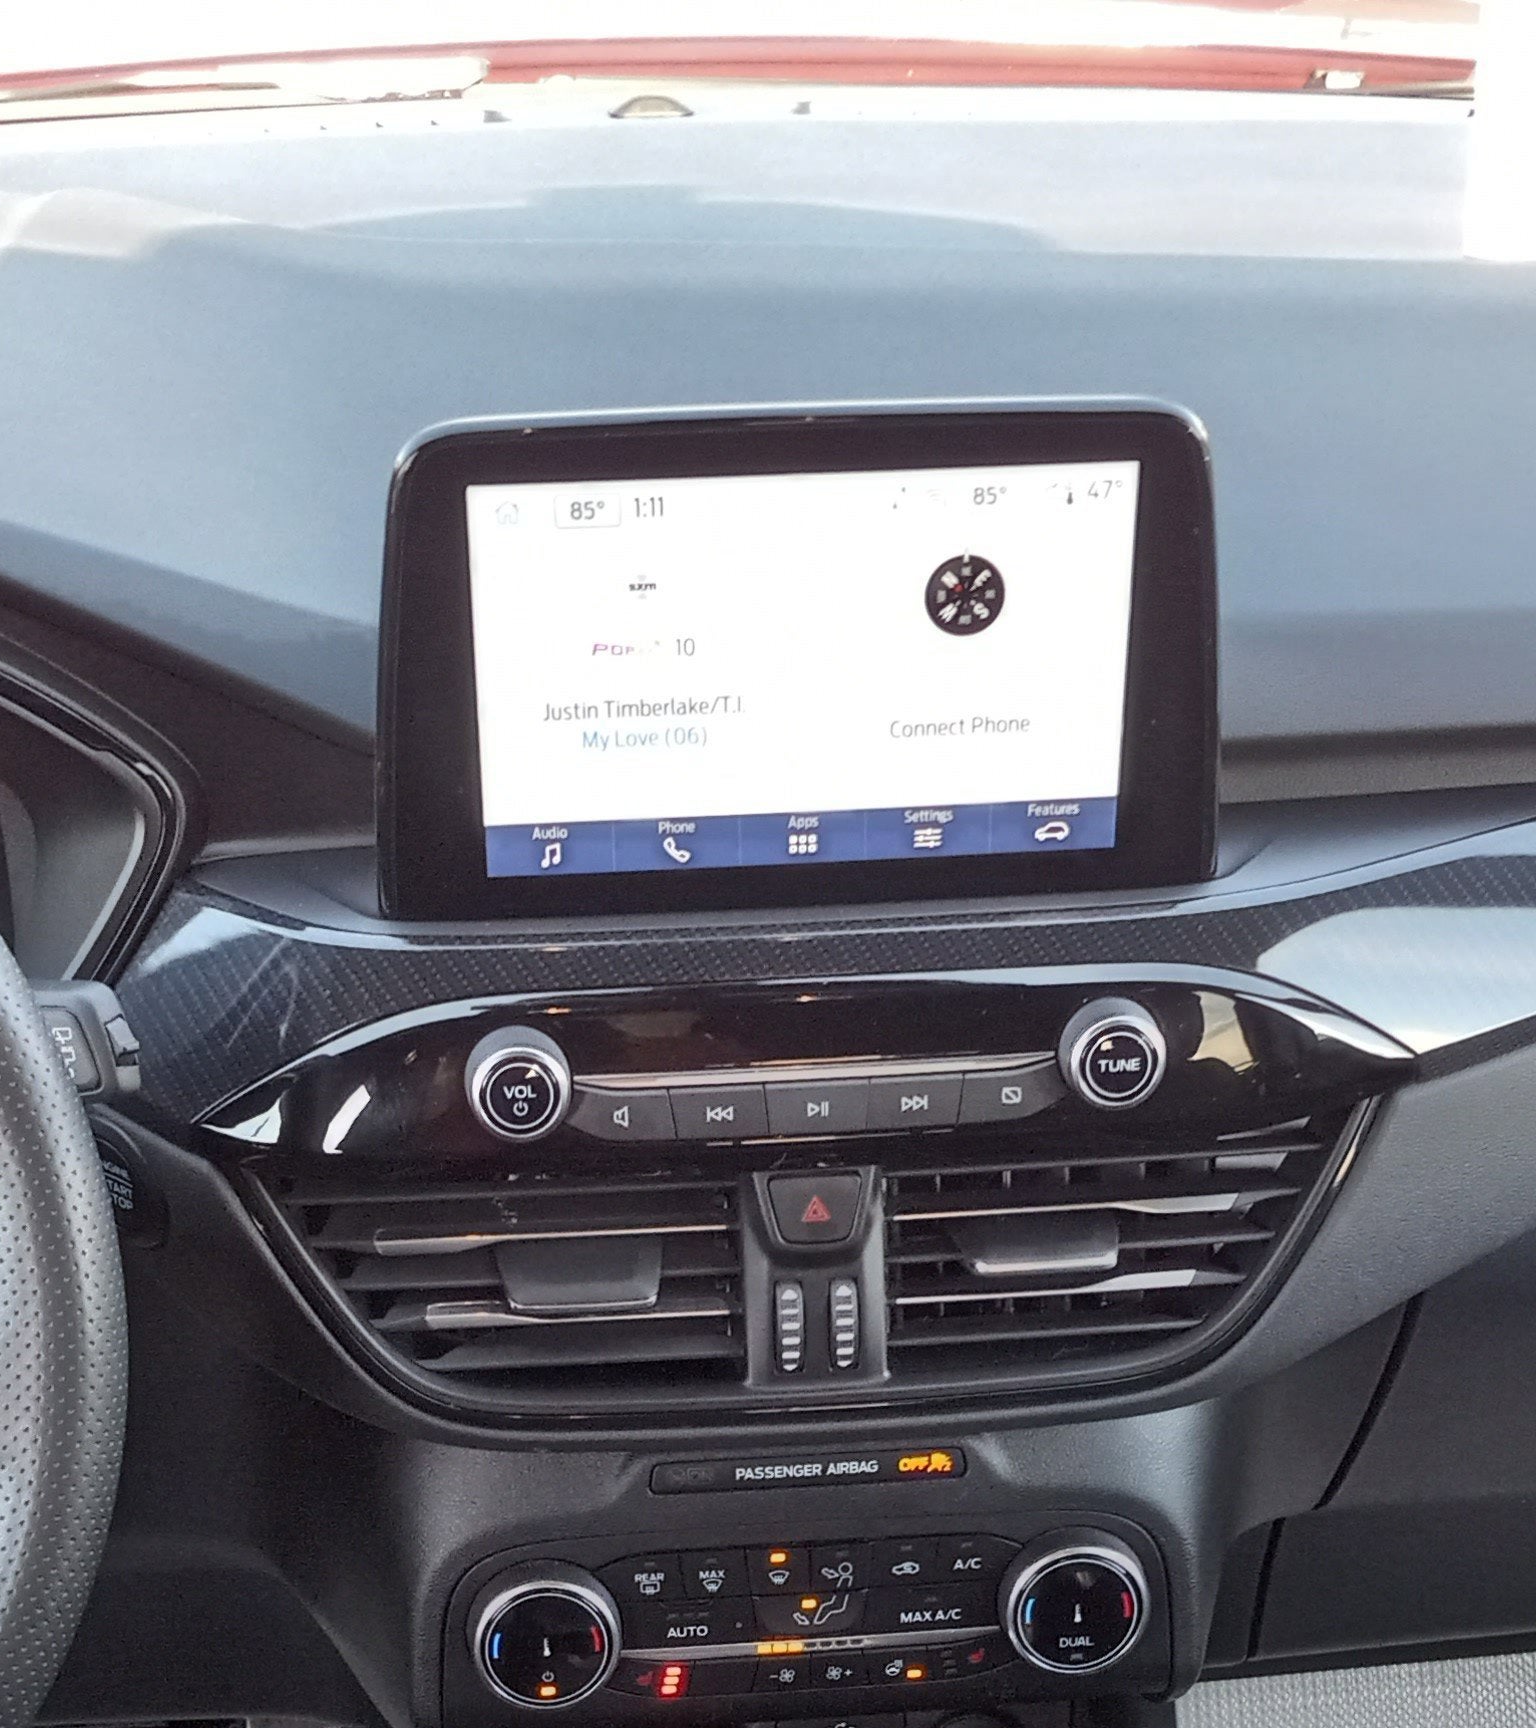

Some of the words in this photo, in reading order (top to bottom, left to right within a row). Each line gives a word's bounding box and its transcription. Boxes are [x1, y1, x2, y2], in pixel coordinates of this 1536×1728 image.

[633, 496, 665, 518] 1:11
[675, 637, 696, 657] 10
[543, 700, 599, 722] Justin
[889, 718, 966, 739] Connect
[971, 716, 1031, 736] Phone
[582, 731, 609, 752] My
[614, 729, 660, 748] Love
[665, 726, 709, 748] (06)
[903, 808, 955, 825] Settings
[1027, 802, 1081, 818] Features
[658, 820, 697, 835] Phone
[787, 814, 820, 831] Apps
[531, 825, 569, 841] Audio
[1096, 1057, 1142, 1074] TUNE
[503, 1084, 538, 1100] VOL
[734, 1462, 823, 1482] PASSENGER
[825, 1459, 880, 1477] AIRBAG
[953, 1556, 983, 1571] A/C
[633, 1572, 665, 1583] REAR
[698, 1568, 726, 1580] MAX
[900, 1610, 934, 1624] MAX
[934, 1607, 963, 1622] A/C
[666, 1624, 709, 1639] AUTO
[1058, 1635, 1095, 1649] DUAL
